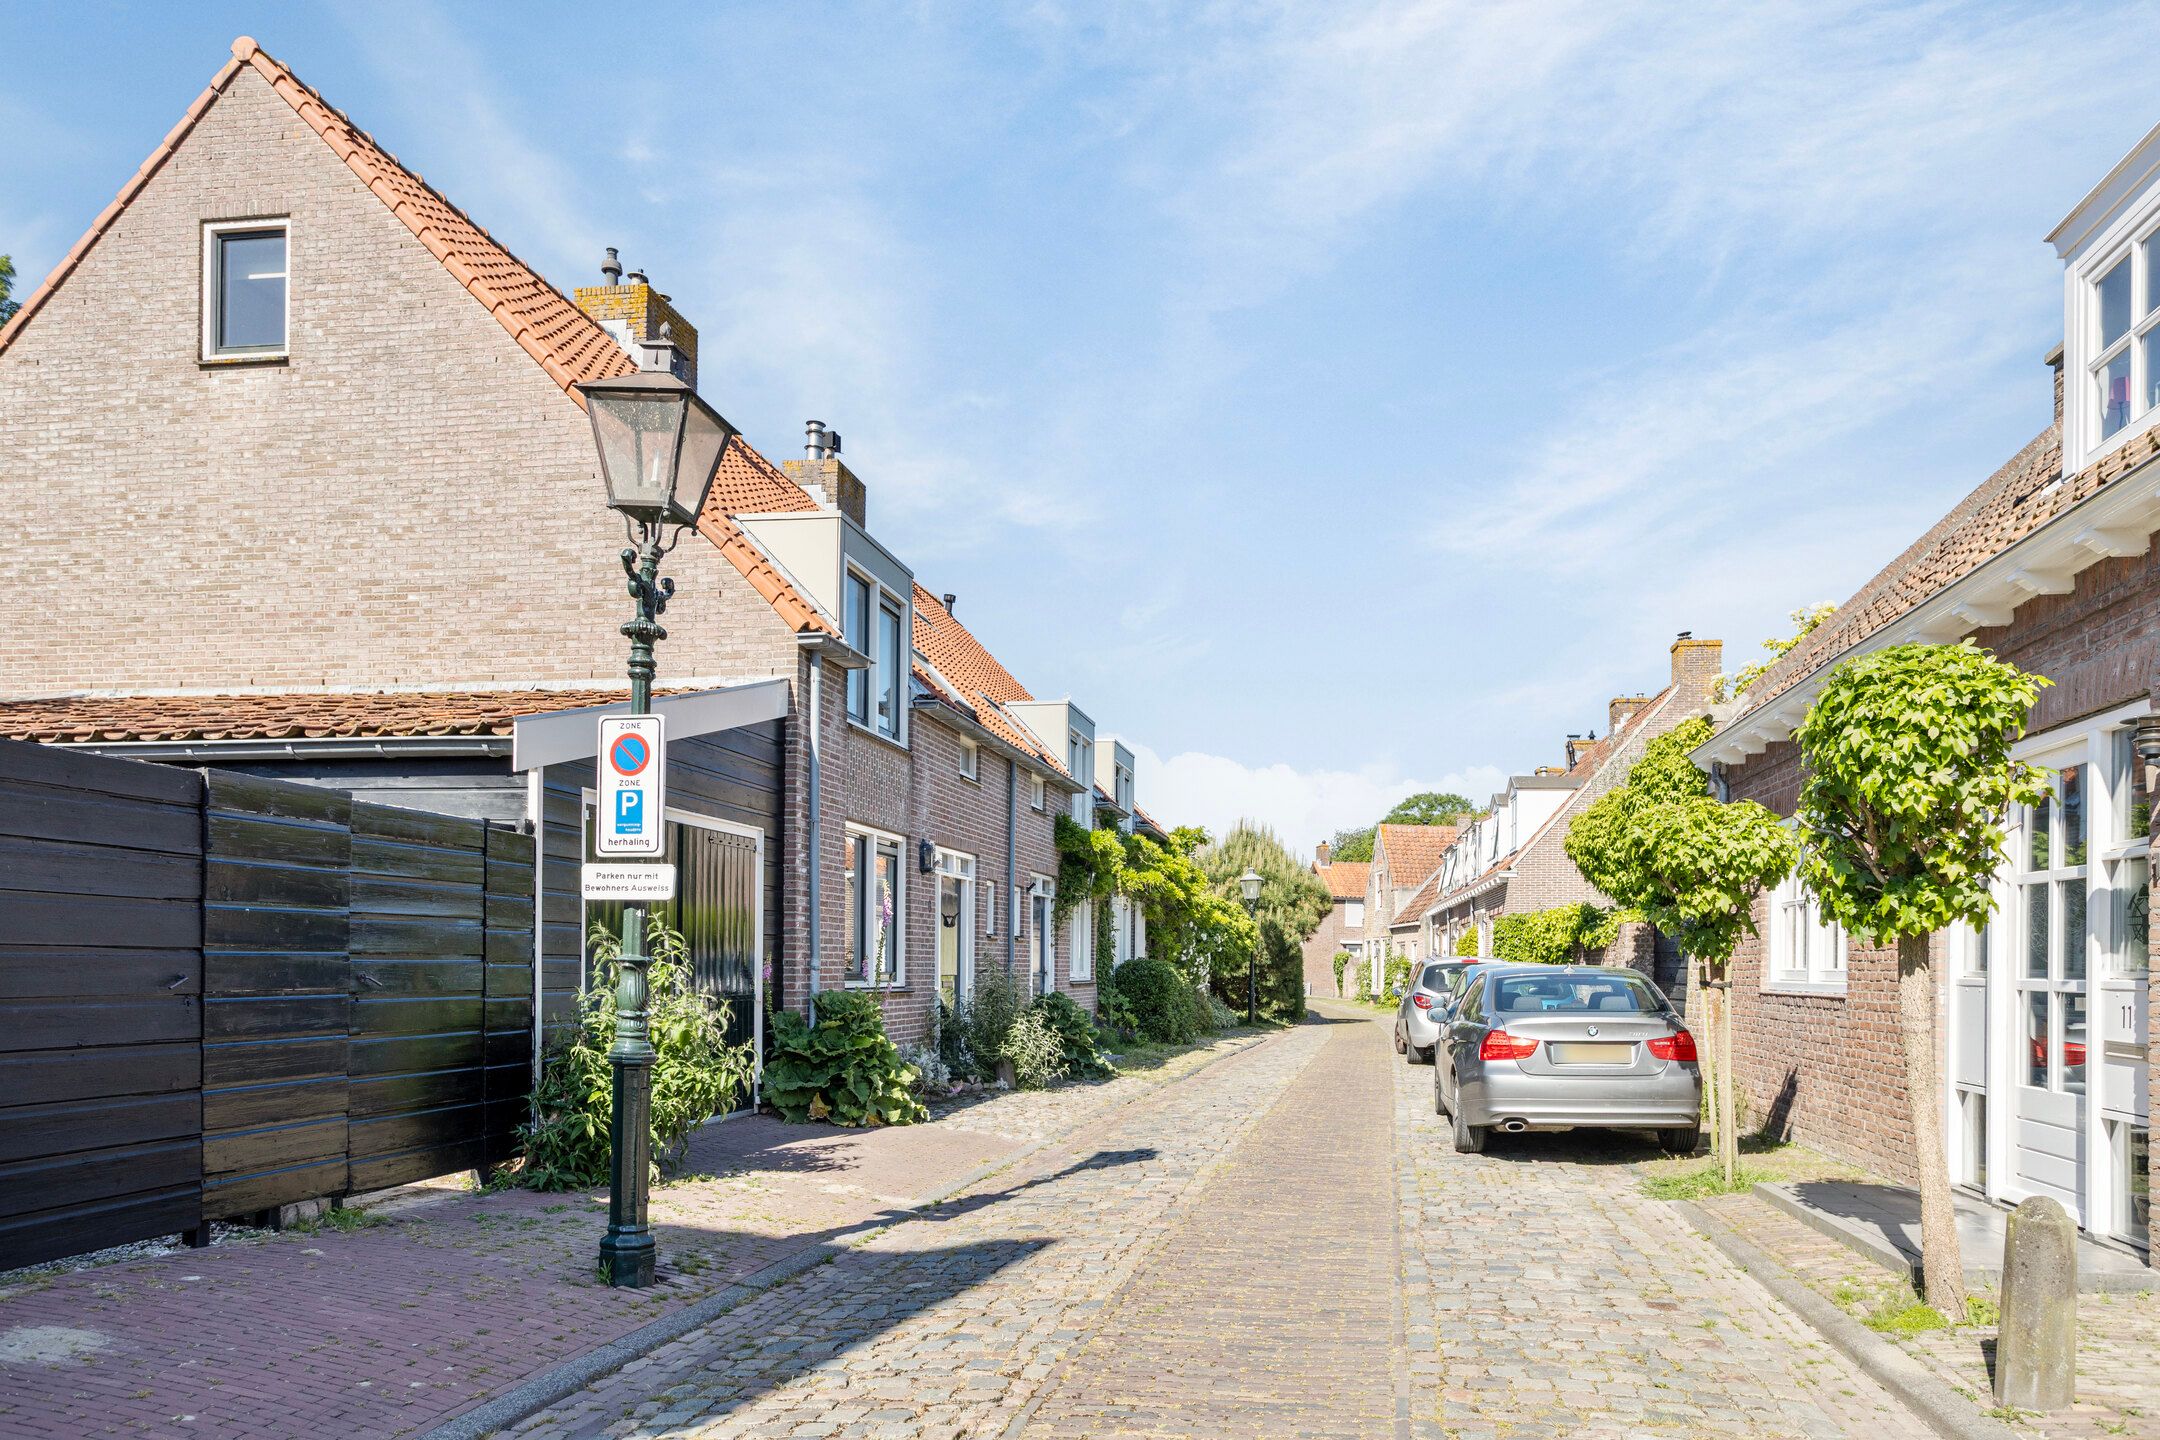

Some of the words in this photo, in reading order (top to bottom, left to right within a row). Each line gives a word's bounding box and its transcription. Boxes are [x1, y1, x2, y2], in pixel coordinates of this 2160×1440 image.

[622, 792, 638, 816] P
[608, 838, 650, 847] herhaling
[596, 872, 625, 880] Parken
[627, 872, 642, 880] nur
[644, 872, 659, 880] mit
[585, 884, 629, 892] Bewohners
[631, 884, 669, 892] Ausweiss
[2121, 1005, 2132, 1029] 11
